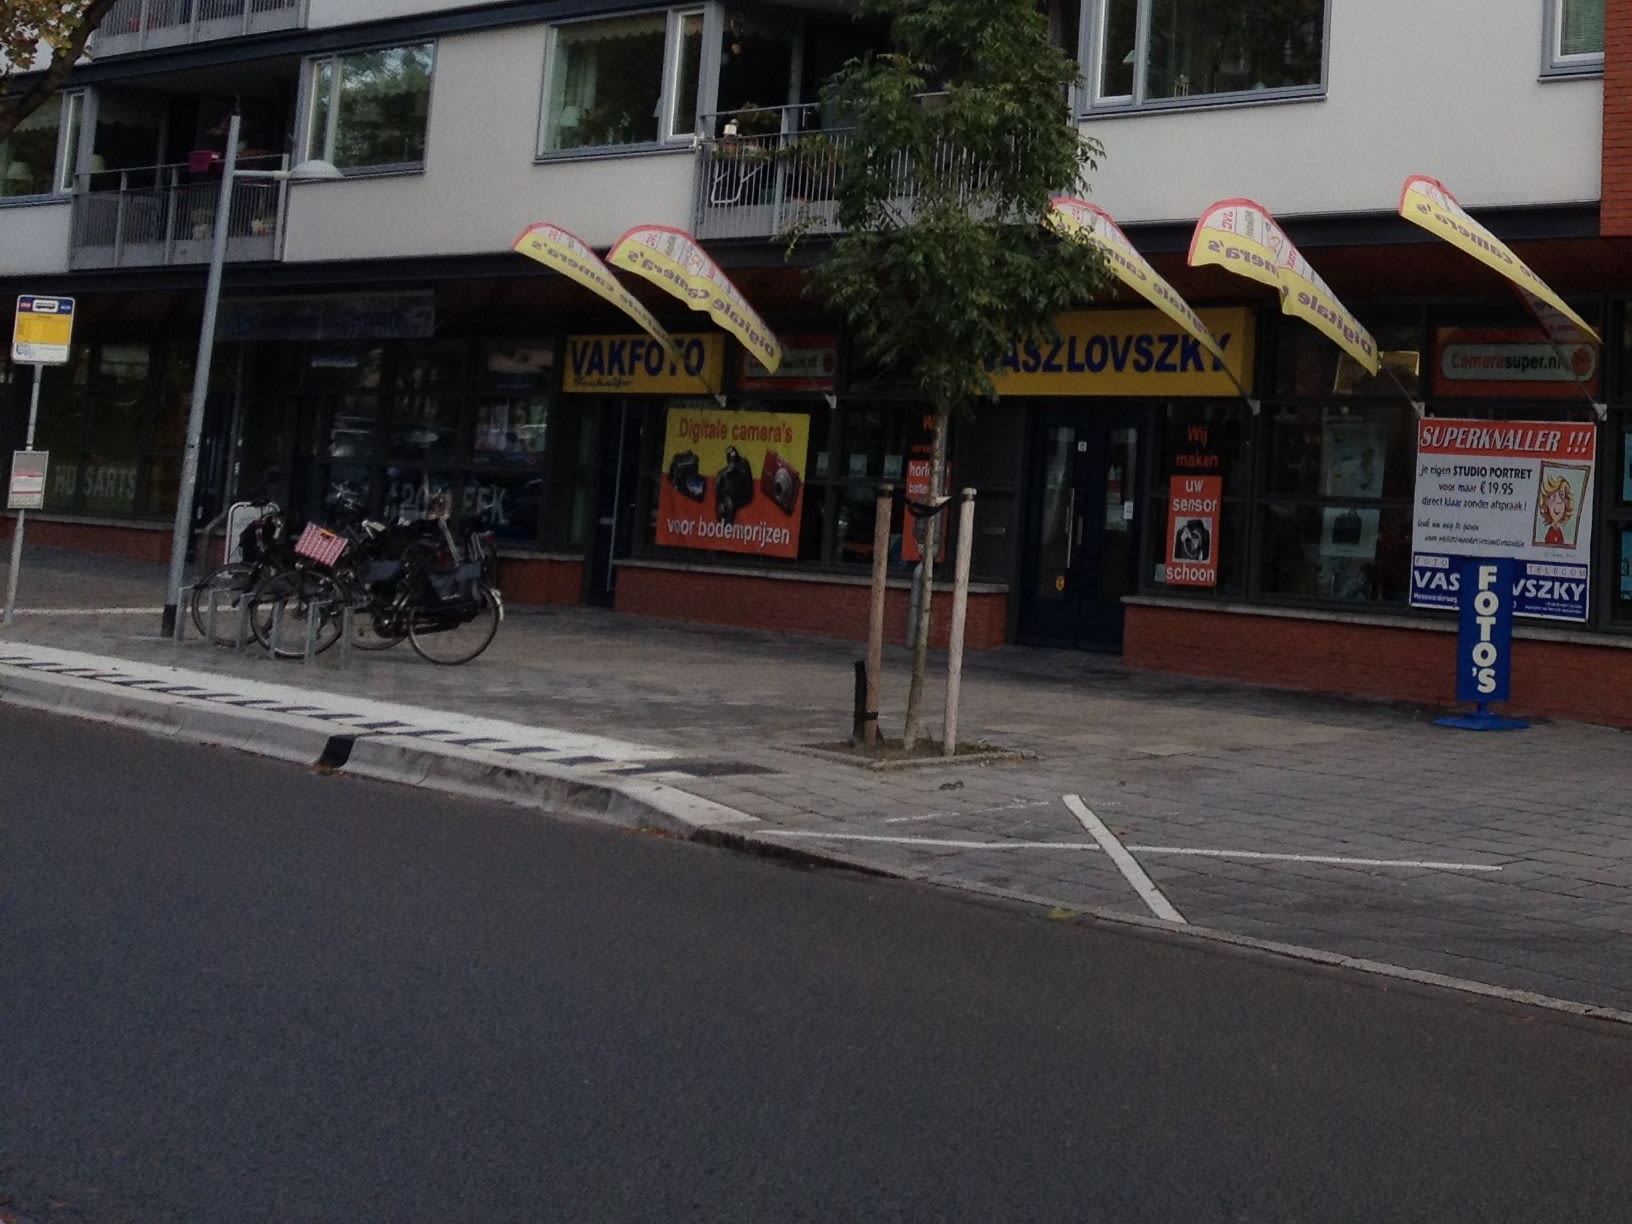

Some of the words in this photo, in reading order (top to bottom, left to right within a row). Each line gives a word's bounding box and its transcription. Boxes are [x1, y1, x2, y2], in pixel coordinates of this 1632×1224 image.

[679, 417, 728, 444] Digitale
[731, 421, 793, 444] camera's
[1420, 425, 1562, 453] SUPERKNALLER
[1566, 431, 1592, 453] !!!
[1453, 465, 1487, 478] STUDIO
[1489, 467, 1533, 480] PORTRET
[1185, 479, 1204, 493] uw
[1172, 497, 1218, 513] sensor
[667, 517, 694, 536] voor
[698, 517, 790, 548] bodemprijzen
[1166, 564, 1216, 582] schoon
[1471, 564, 1500, 694] FOTO'S
